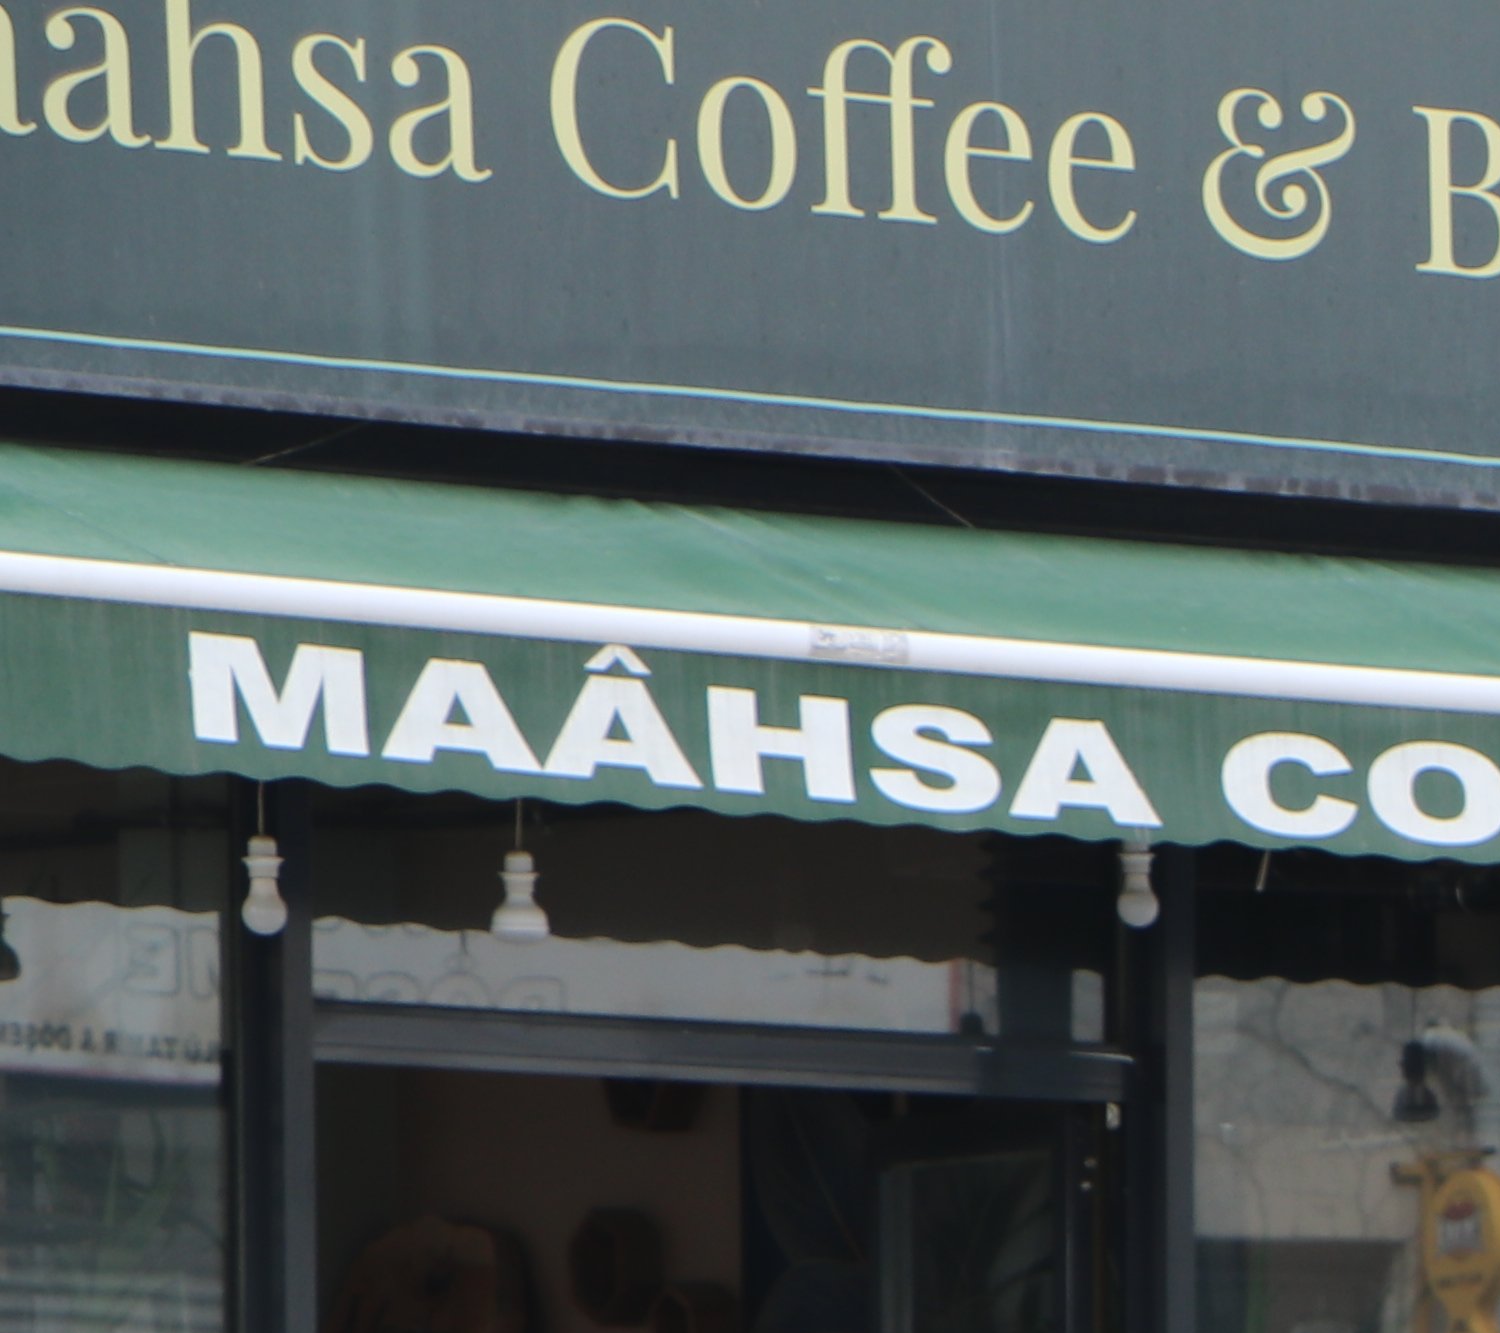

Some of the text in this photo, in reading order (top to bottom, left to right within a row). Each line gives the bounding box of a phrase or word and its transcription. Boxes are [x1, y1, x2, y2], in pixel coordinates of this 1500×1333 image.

[549, 18, 1137, 242] Coffee
[1202, 87, 1356, 259] &
[188, 630, 1161, 829] MAÂHSA
